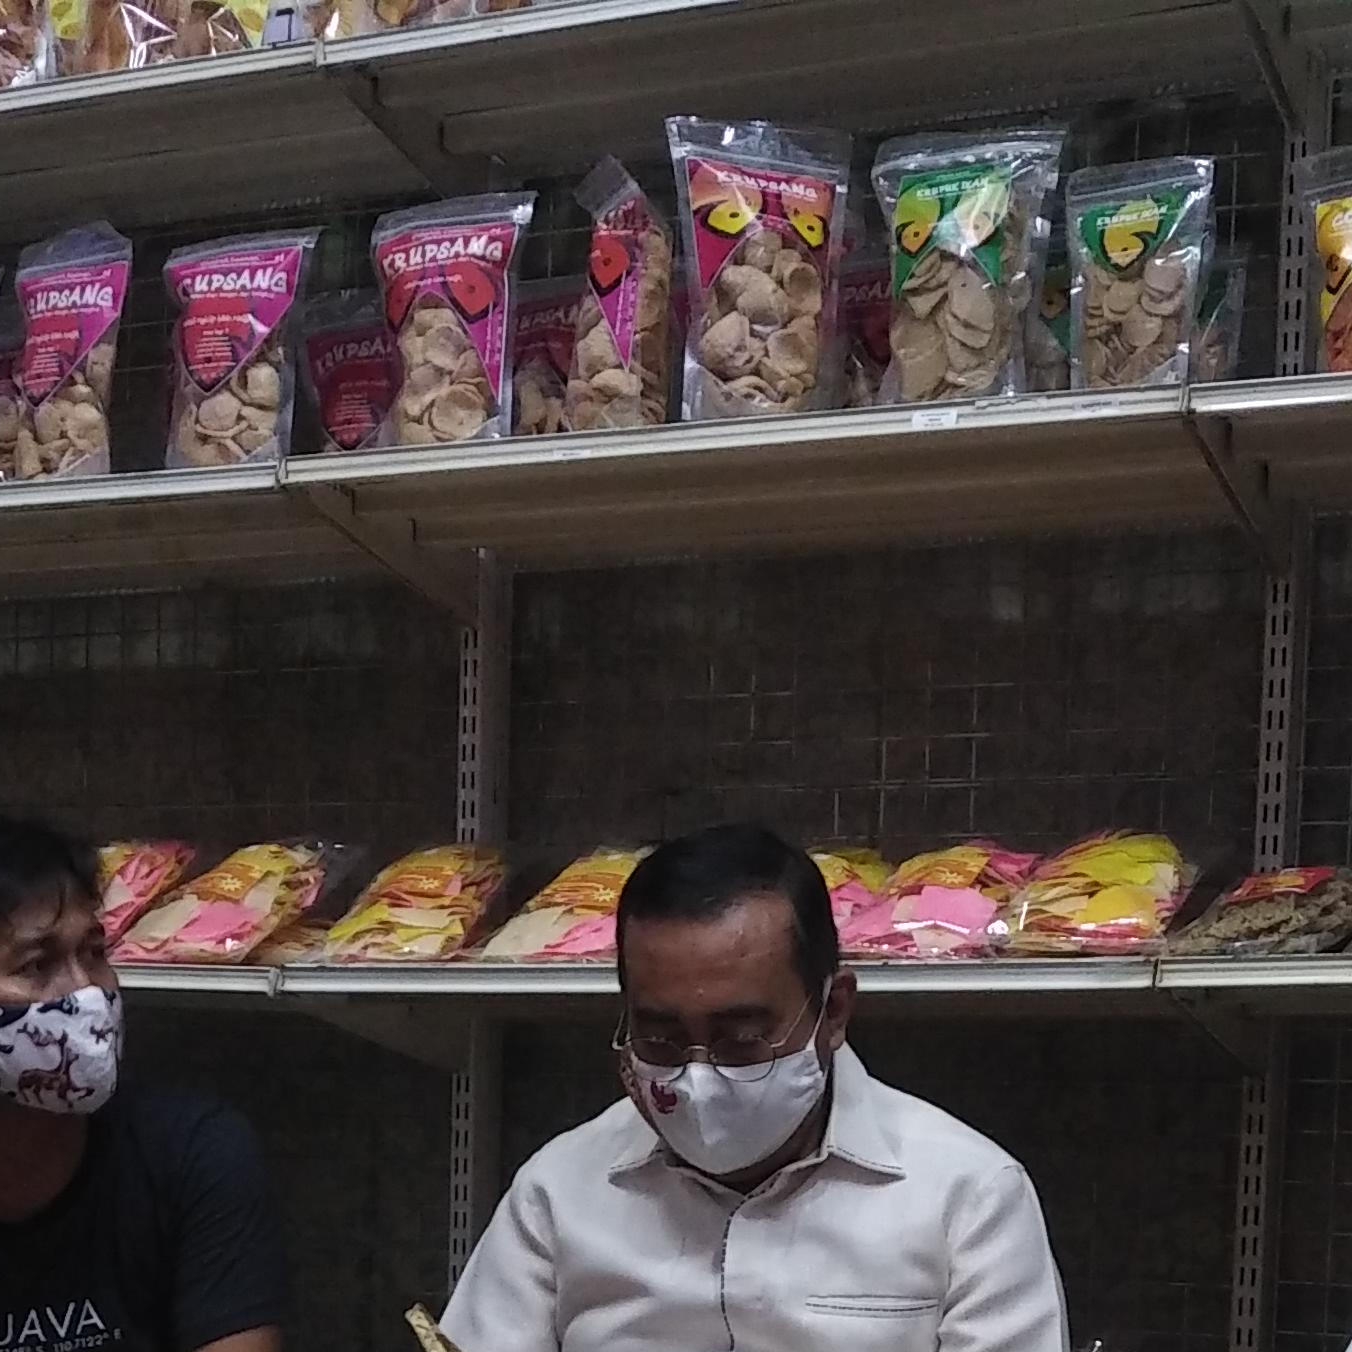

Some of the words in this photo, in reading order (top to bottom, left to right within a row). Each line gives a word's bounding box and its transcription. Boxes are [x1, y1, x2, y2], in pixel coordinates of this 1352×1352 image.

[382, 234, 503, 276] KRUPSANG
[182, 266, 288, 294] UPSANG
[29, 282, 114, 315] UPSANG
[315, 336, 394, 376] KRUPSA
